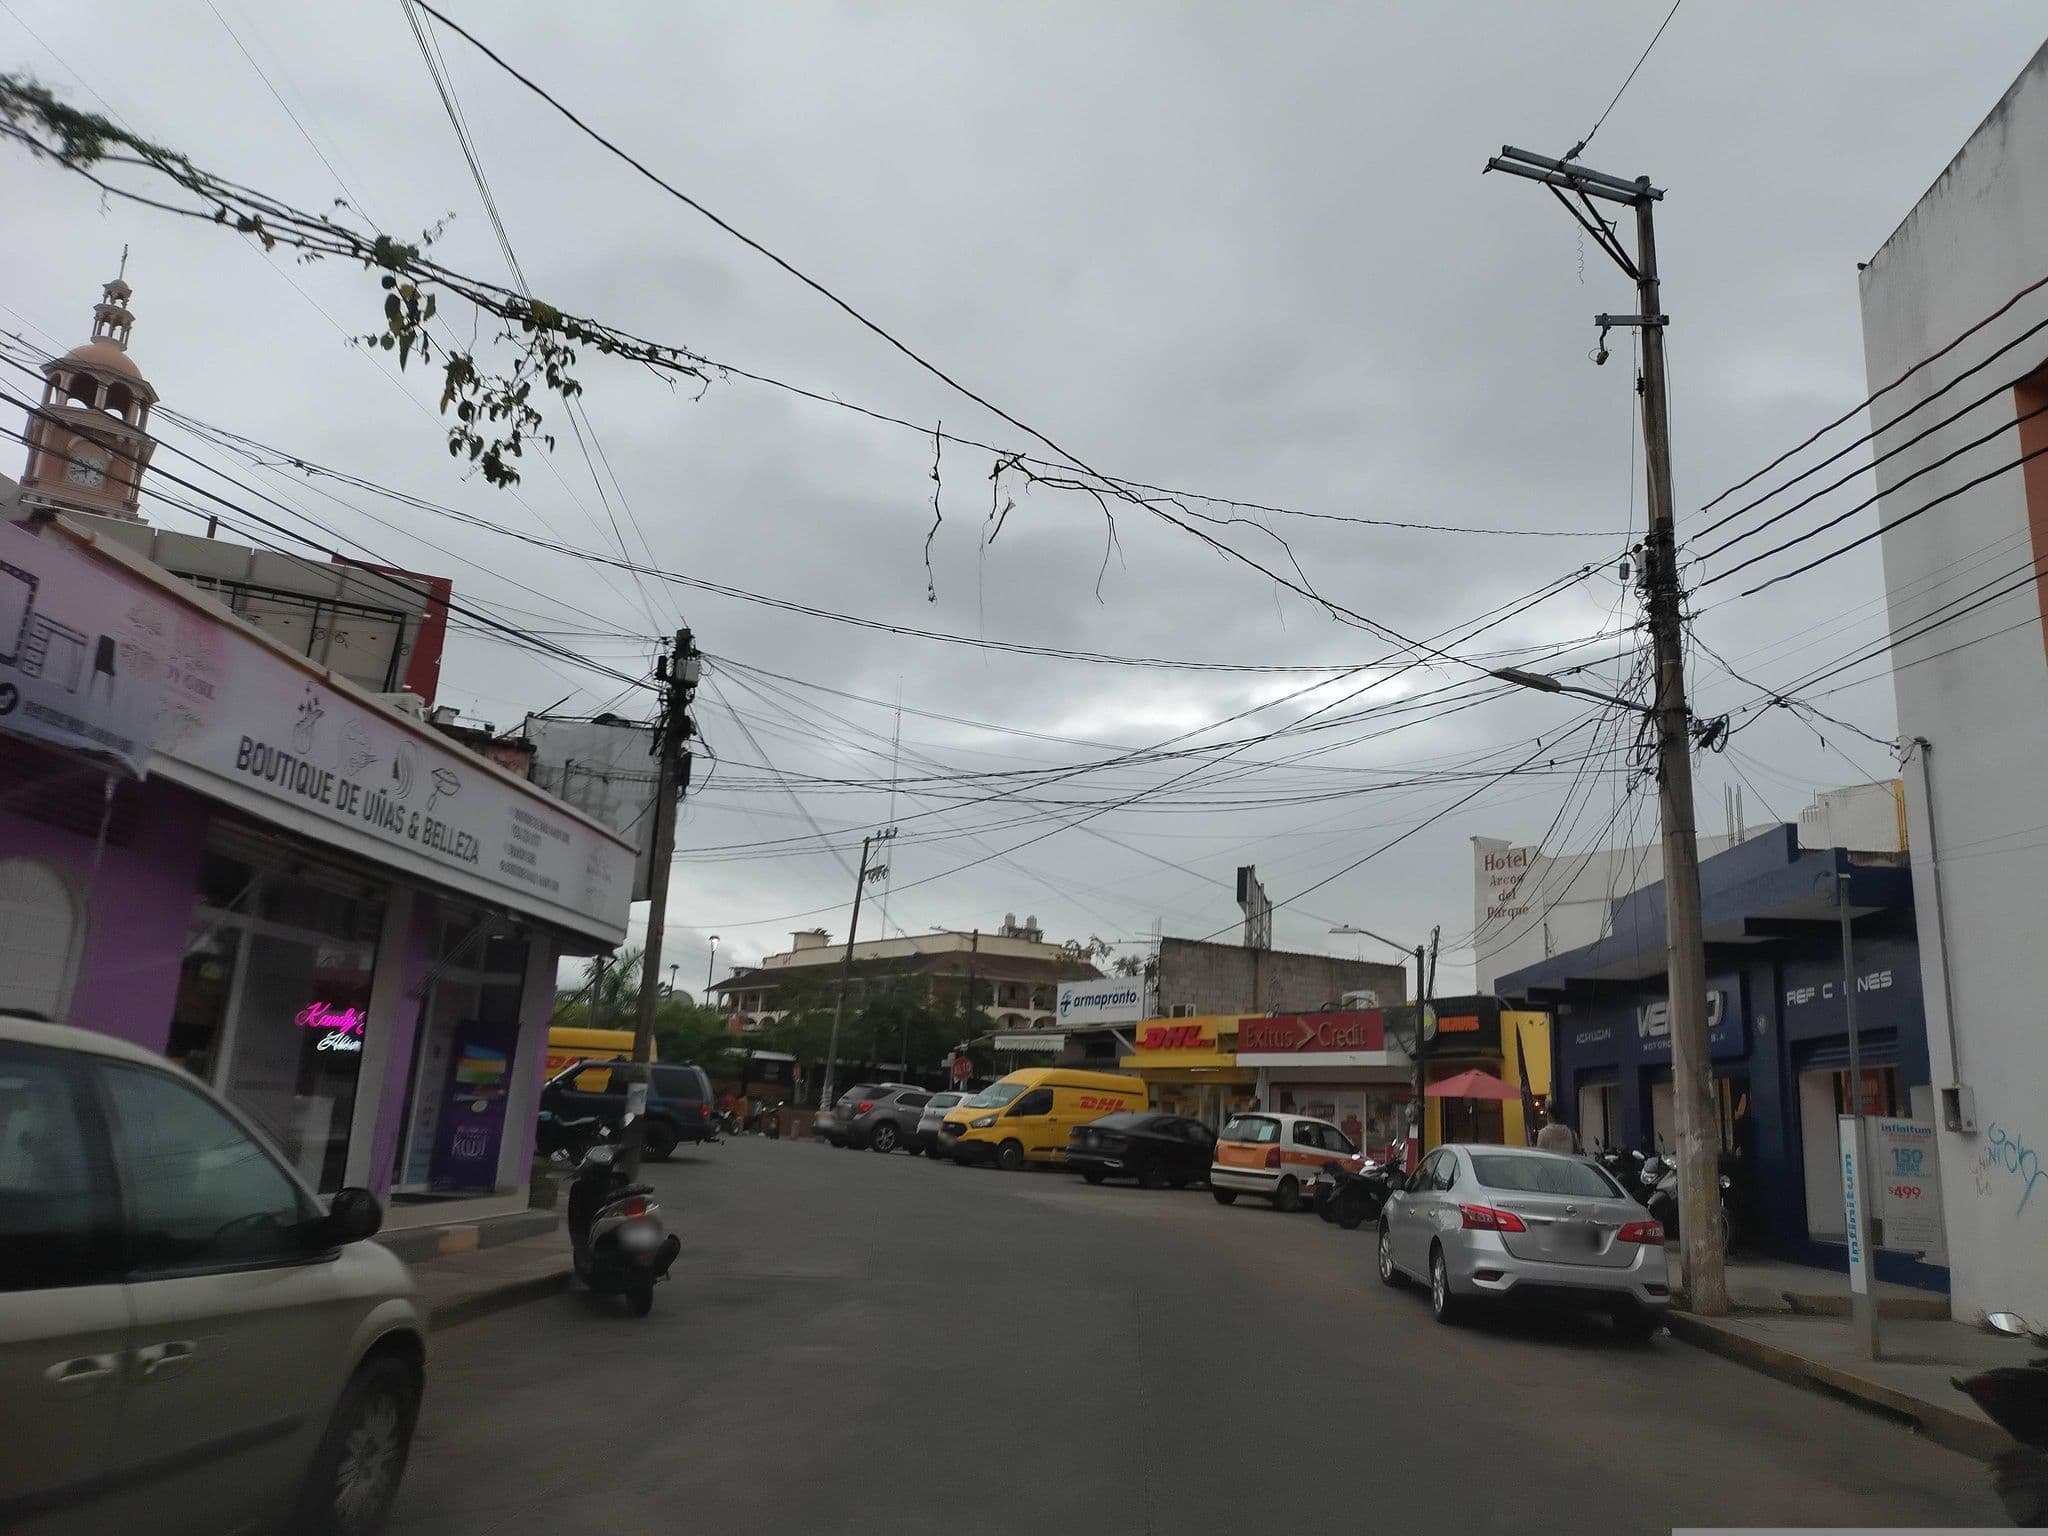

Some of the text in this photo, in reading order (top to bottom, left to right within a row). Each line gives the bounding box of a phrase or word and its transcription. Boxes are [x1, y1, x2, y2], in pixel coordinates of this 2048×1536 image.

[236, 734, 335, 805] BOUTIQUE
[336, 778, 361, 816] DE
[363, 789, 406, 834] UÑAS
[407, 810, 420, 841] &
[421, 816, 480, 865] BELLEZA
[1484, 848, 1527, 871] Hotel
[1498, 888, 1516, 901] del
[1487, 905, 1530, 920] Parque
[1143, 1025, 1202, 1049] DHL
[1246, 1021, 1366, 1049] Exitus Credit
[1080, 1096, 1127, 1112] DHL
[1881, 1122, 1932, 1135] infinitum
